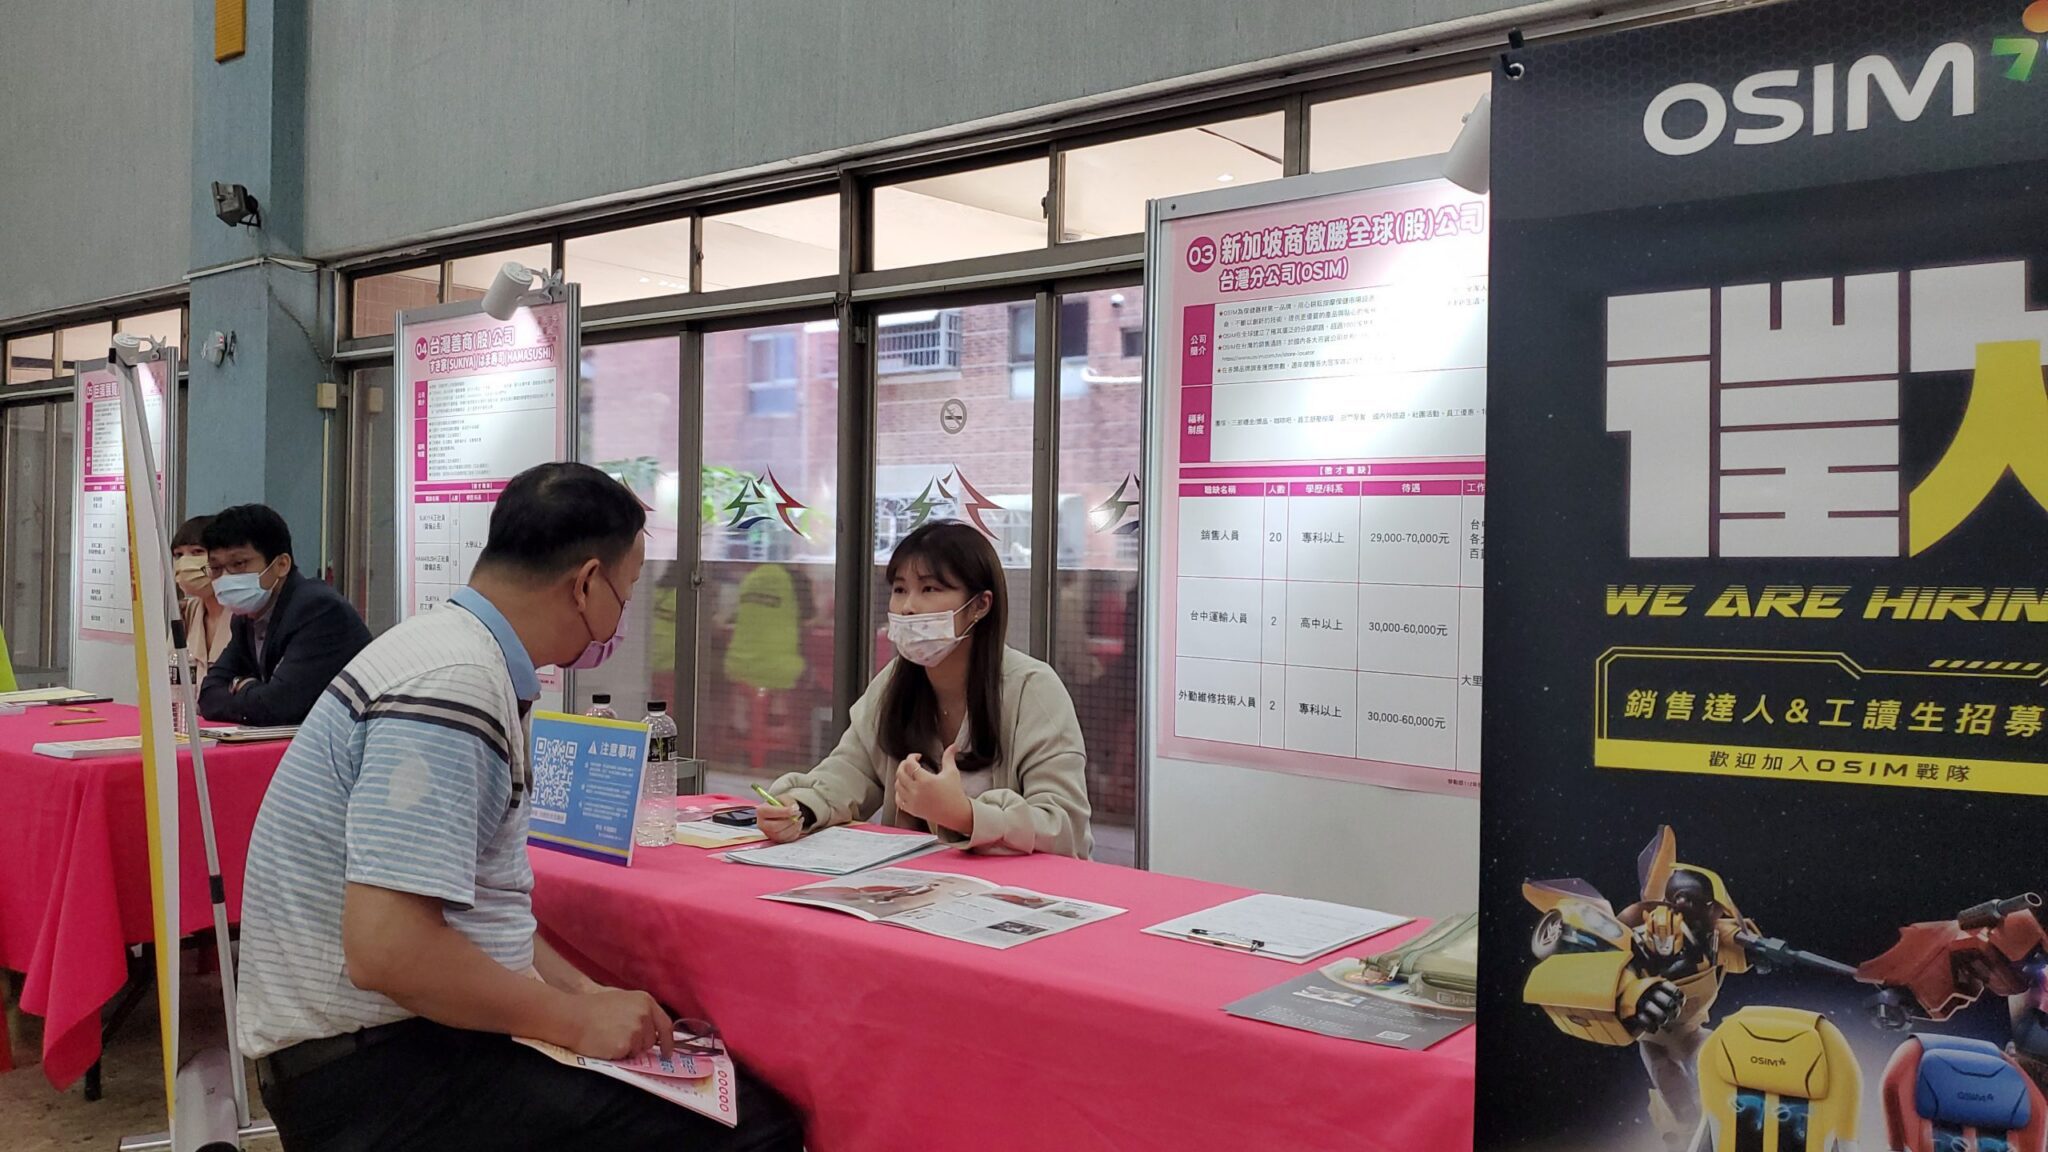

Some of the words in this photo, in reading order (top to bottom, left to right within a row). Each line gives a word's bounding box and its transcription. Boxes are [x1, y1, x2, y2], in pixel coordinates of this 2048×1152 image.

[1643, 42, 1975, 156] OSIM
[1219, 201, 1485, 265] 新加坡商傲勝全球(股)公司
[1189, 246, 1214, 266] 03
[1218, 257, 1349, 293] 台灣分公司(OSIM)
[1190, 335, 1207, 345] 公司
[416, 344, 428, 354] 04
[1190, 346, 1207, 356] 簡介
[1188, 414, 1205, 424] 福利
[1187, 425, 1204, 435] 制度
[1204, 485, 1236, 495] 職缺名稱
[1268, 485, 1286, 495] 人數
[1305, 484, 1344, 494] 學歷/科系
[1401, 483, 1421, 493] 待遇
[1200, 529, 1240, 542] 銷售人員
[1269, 532, 1282, 543] 20
[1301, 532, 1345, 545] 專科以上
[1370, 532, 1450, 546] 29,000-70,000元
[1605, 584, 1696, 617] WE
[1705, 585, 1852, 619] ARE
[1190, 610, 1248, 625] 台中運輸人員
[1271, 616, 1277, 627] 2
[1300, 617, 1343, 631] 高中以上
[1369, 621, 1448, 637] 30,000-60,000元
[1178, 689, 1256, 709] 外勤維修技術人員
[1269, 700, 1275, 711] 2
[1298, 701, 1342, 719] 專科以上
[1624, 688, 2046, 738] 銷售達人&工讀生招募
[1367, 711, 1446, 730] 30,000-60,000元
[600, 741, 637, 761] 注意事項
[1708, 750, 1972, 783] 歡迎加入OSIM戰隊
[1751, 1056, 1778, 1067] OSIM
